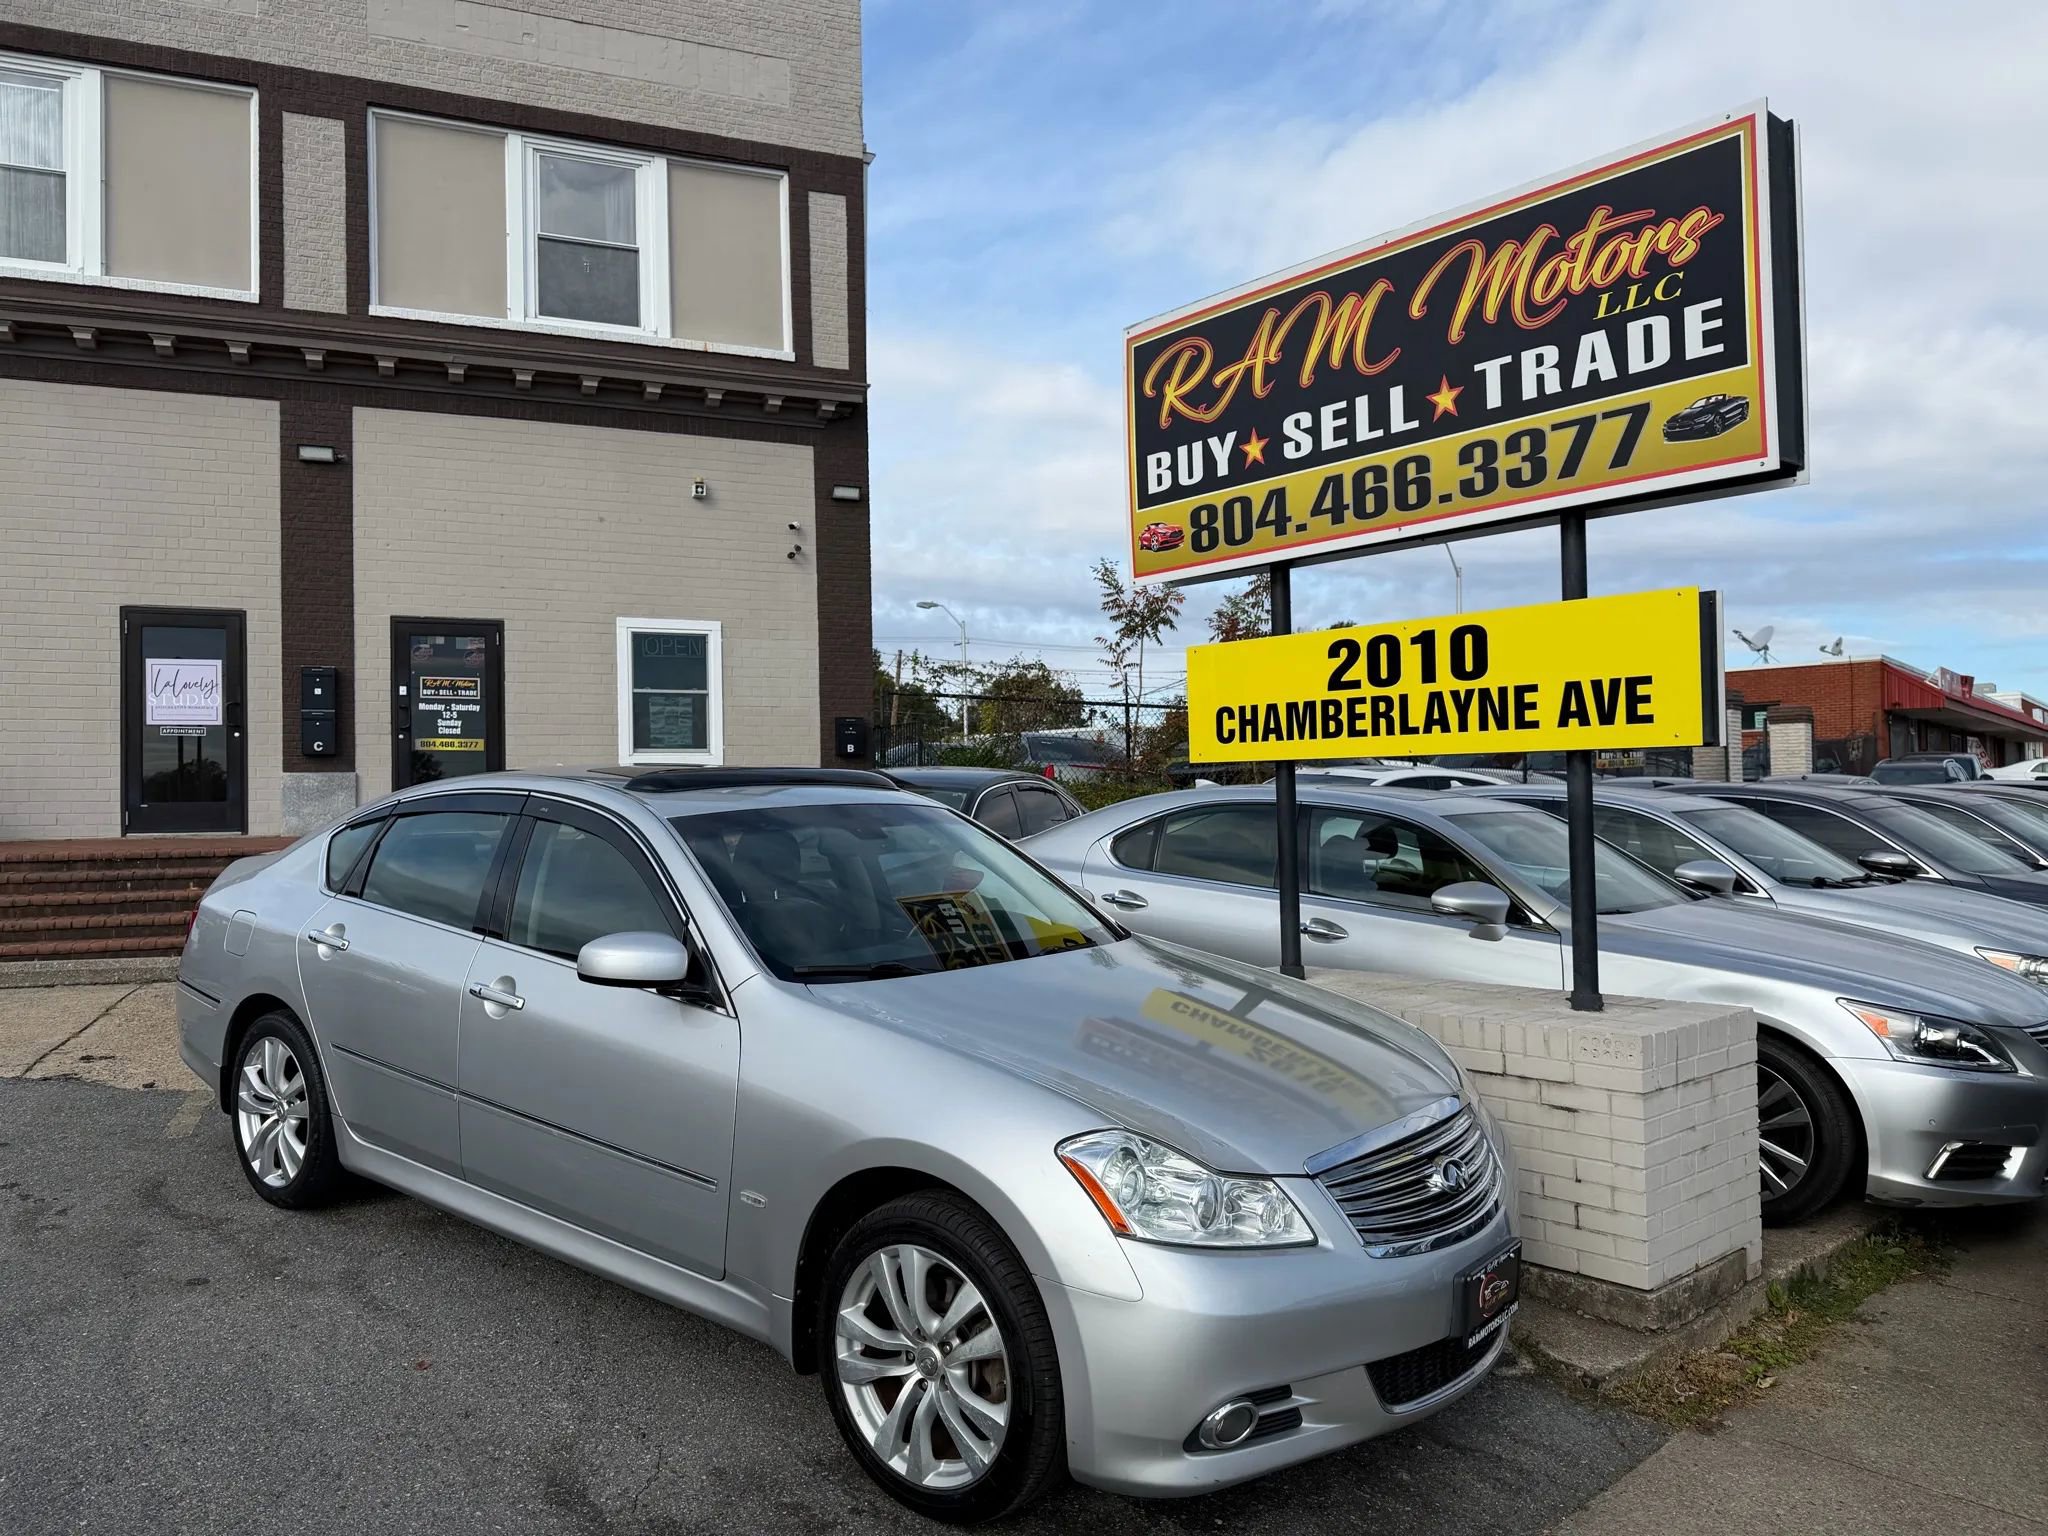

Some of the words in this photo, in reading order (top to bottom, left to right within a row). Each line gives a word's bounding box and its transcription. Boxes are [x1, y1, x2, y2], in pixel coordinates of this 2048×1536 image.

[1593, 271, 1684, 321] LLC
[1143, 278, 1401, 429] RAM
[1409, 205, 1725, 346] Motors
[1146, 429, 1238, 496] BUY
[1283, 384, 1421, 461] SELL
[1474, 297, 1725, 411] TRADE
[1189, 401, 1652, 554] 804.466.3377
[643, 637, 703, 656] OPEN
[1327, 624, 1489, 692] 2010
[418, 703, 445, 712] Monday
[451, 703, 480, 712] Saturday
[442, 711, 458, 719] 12-5
[1215, 683, 1540, 745] CHAMBERLAYNE
[1557, 675, 1655, 729] AVE
[437, 719, 462, 727] Sunday
[438, 726, 461, 735] Closed
[313, 741, 324, 752] C
[846, 744, 855, 753] B
